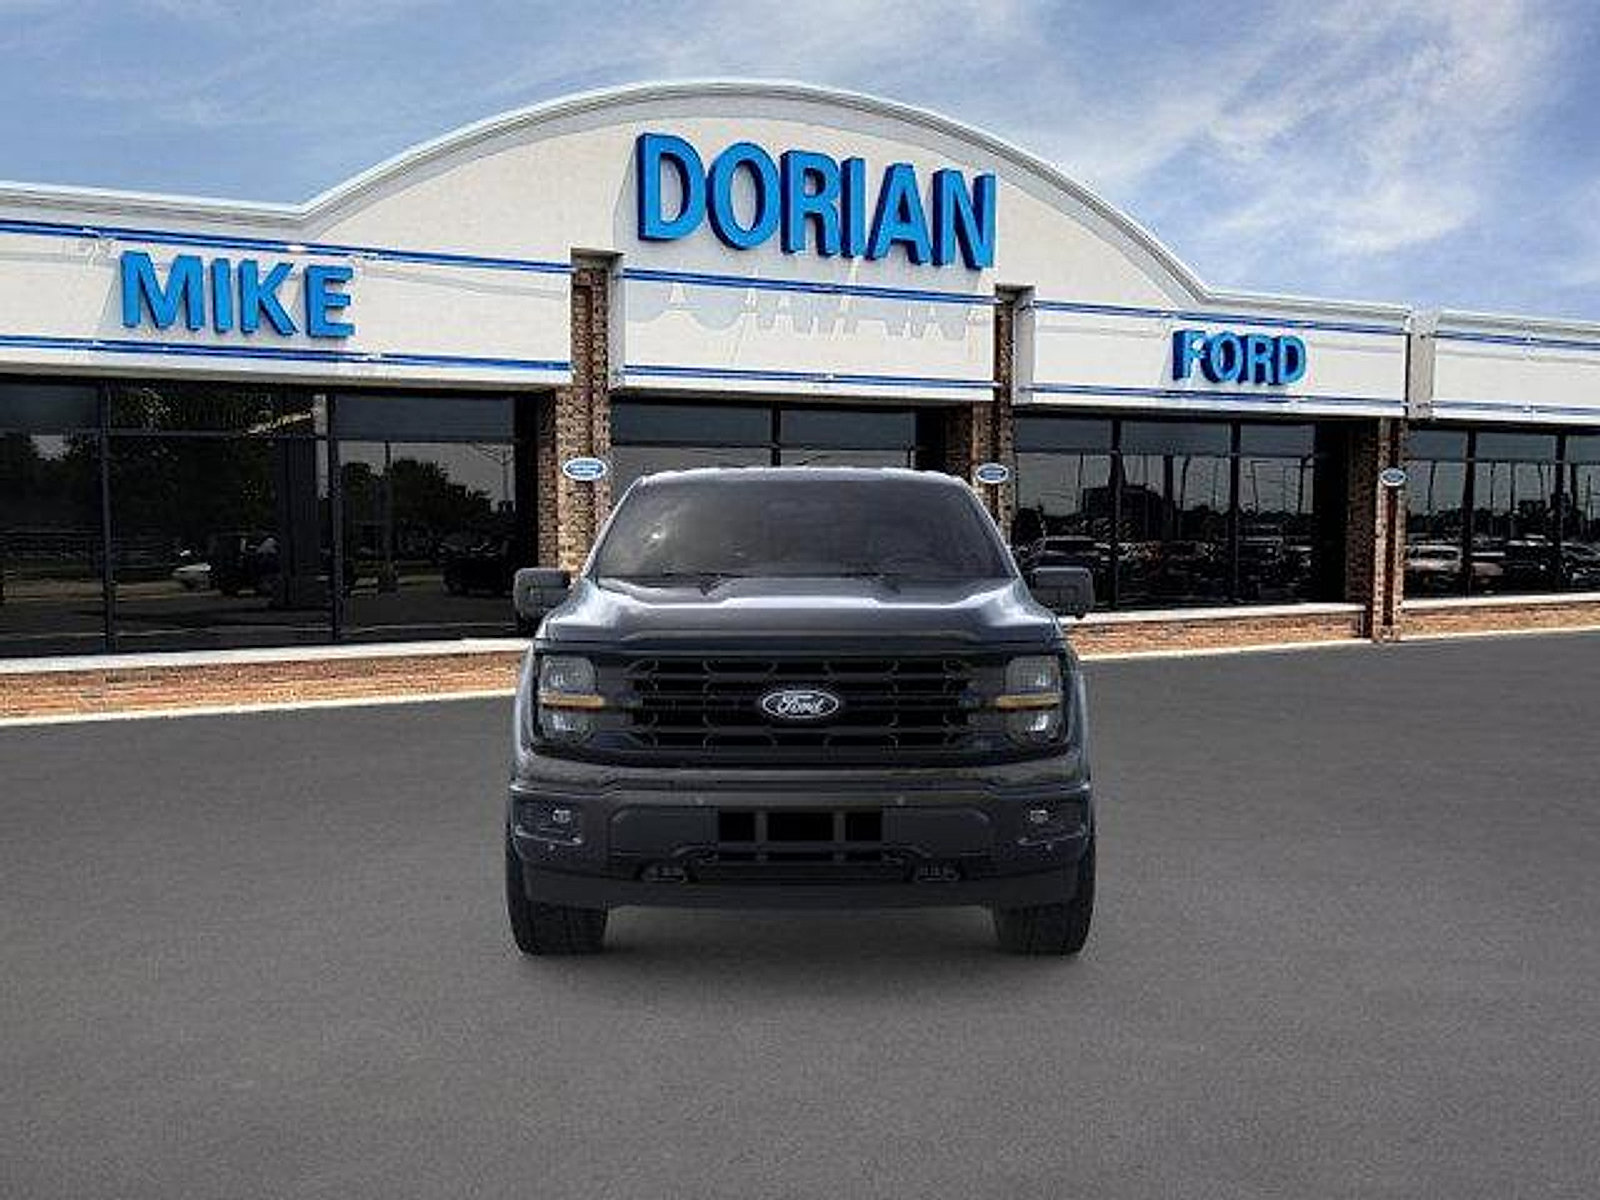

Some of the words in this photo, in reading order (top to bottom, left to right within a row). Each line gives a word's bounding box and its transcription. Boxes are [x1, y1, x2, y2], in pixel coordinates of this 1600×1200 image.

[636, 132, 996, 271] DORIAN
[119, 250, 356, 338] MIKE
[1172, 330, 1307, 386] FORD
[777, 693, 824, 714] Ford
